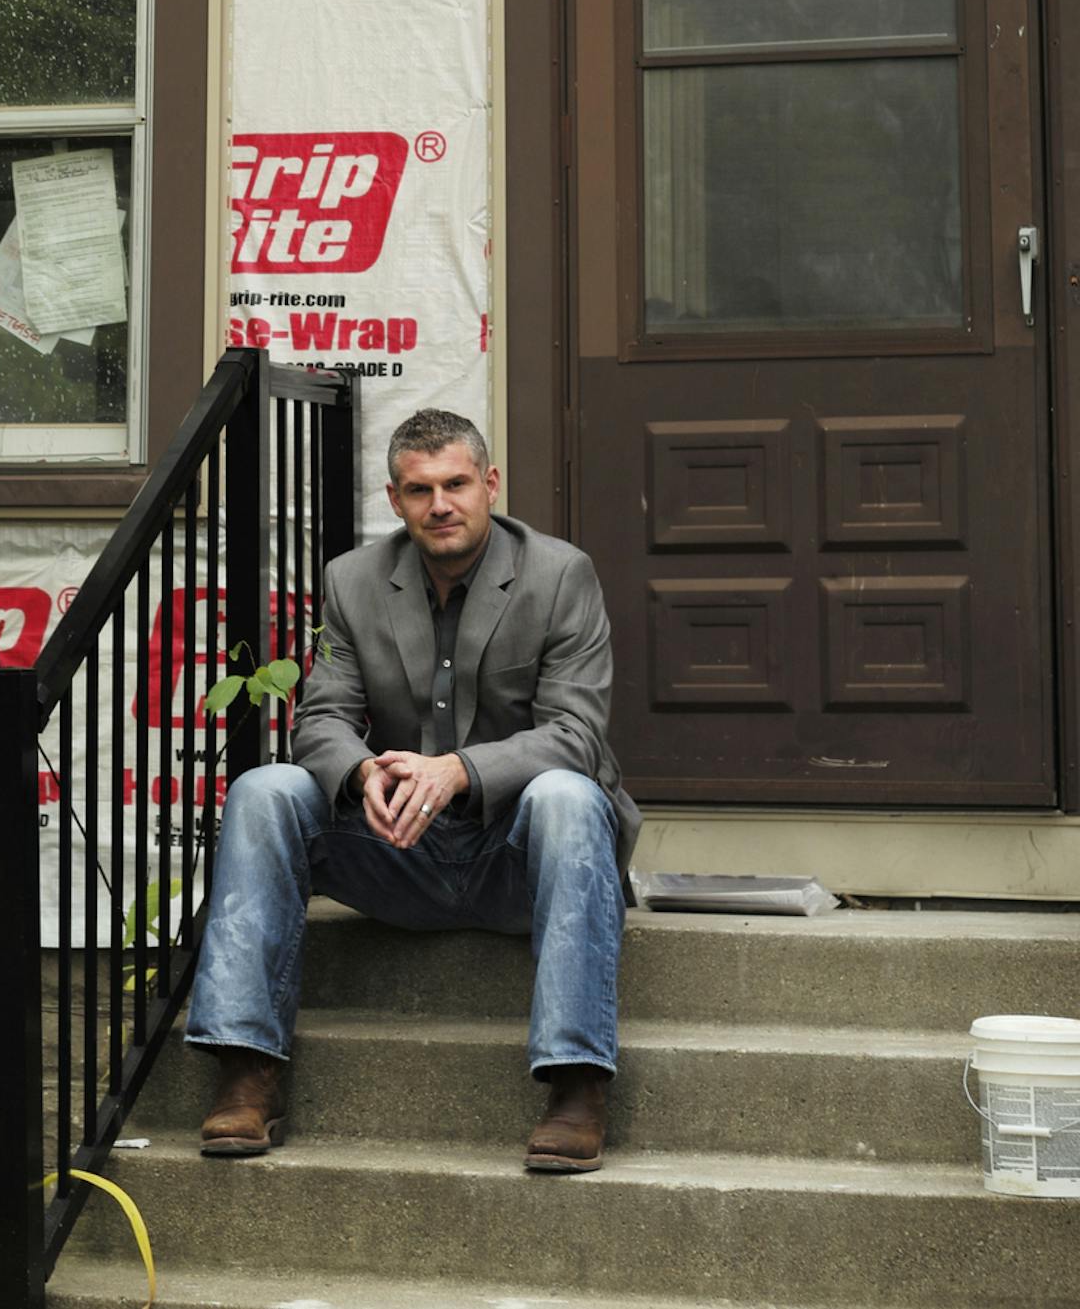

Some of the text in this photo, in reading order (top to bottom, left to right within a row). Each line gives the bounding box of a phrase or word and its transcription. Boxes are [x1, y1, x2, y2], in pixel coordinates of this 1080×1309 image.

[230, 290, 346, 308] grip-rite.com
[230, 312, 418, 354] se-Wrap
[391, 363, 403, 377] D
